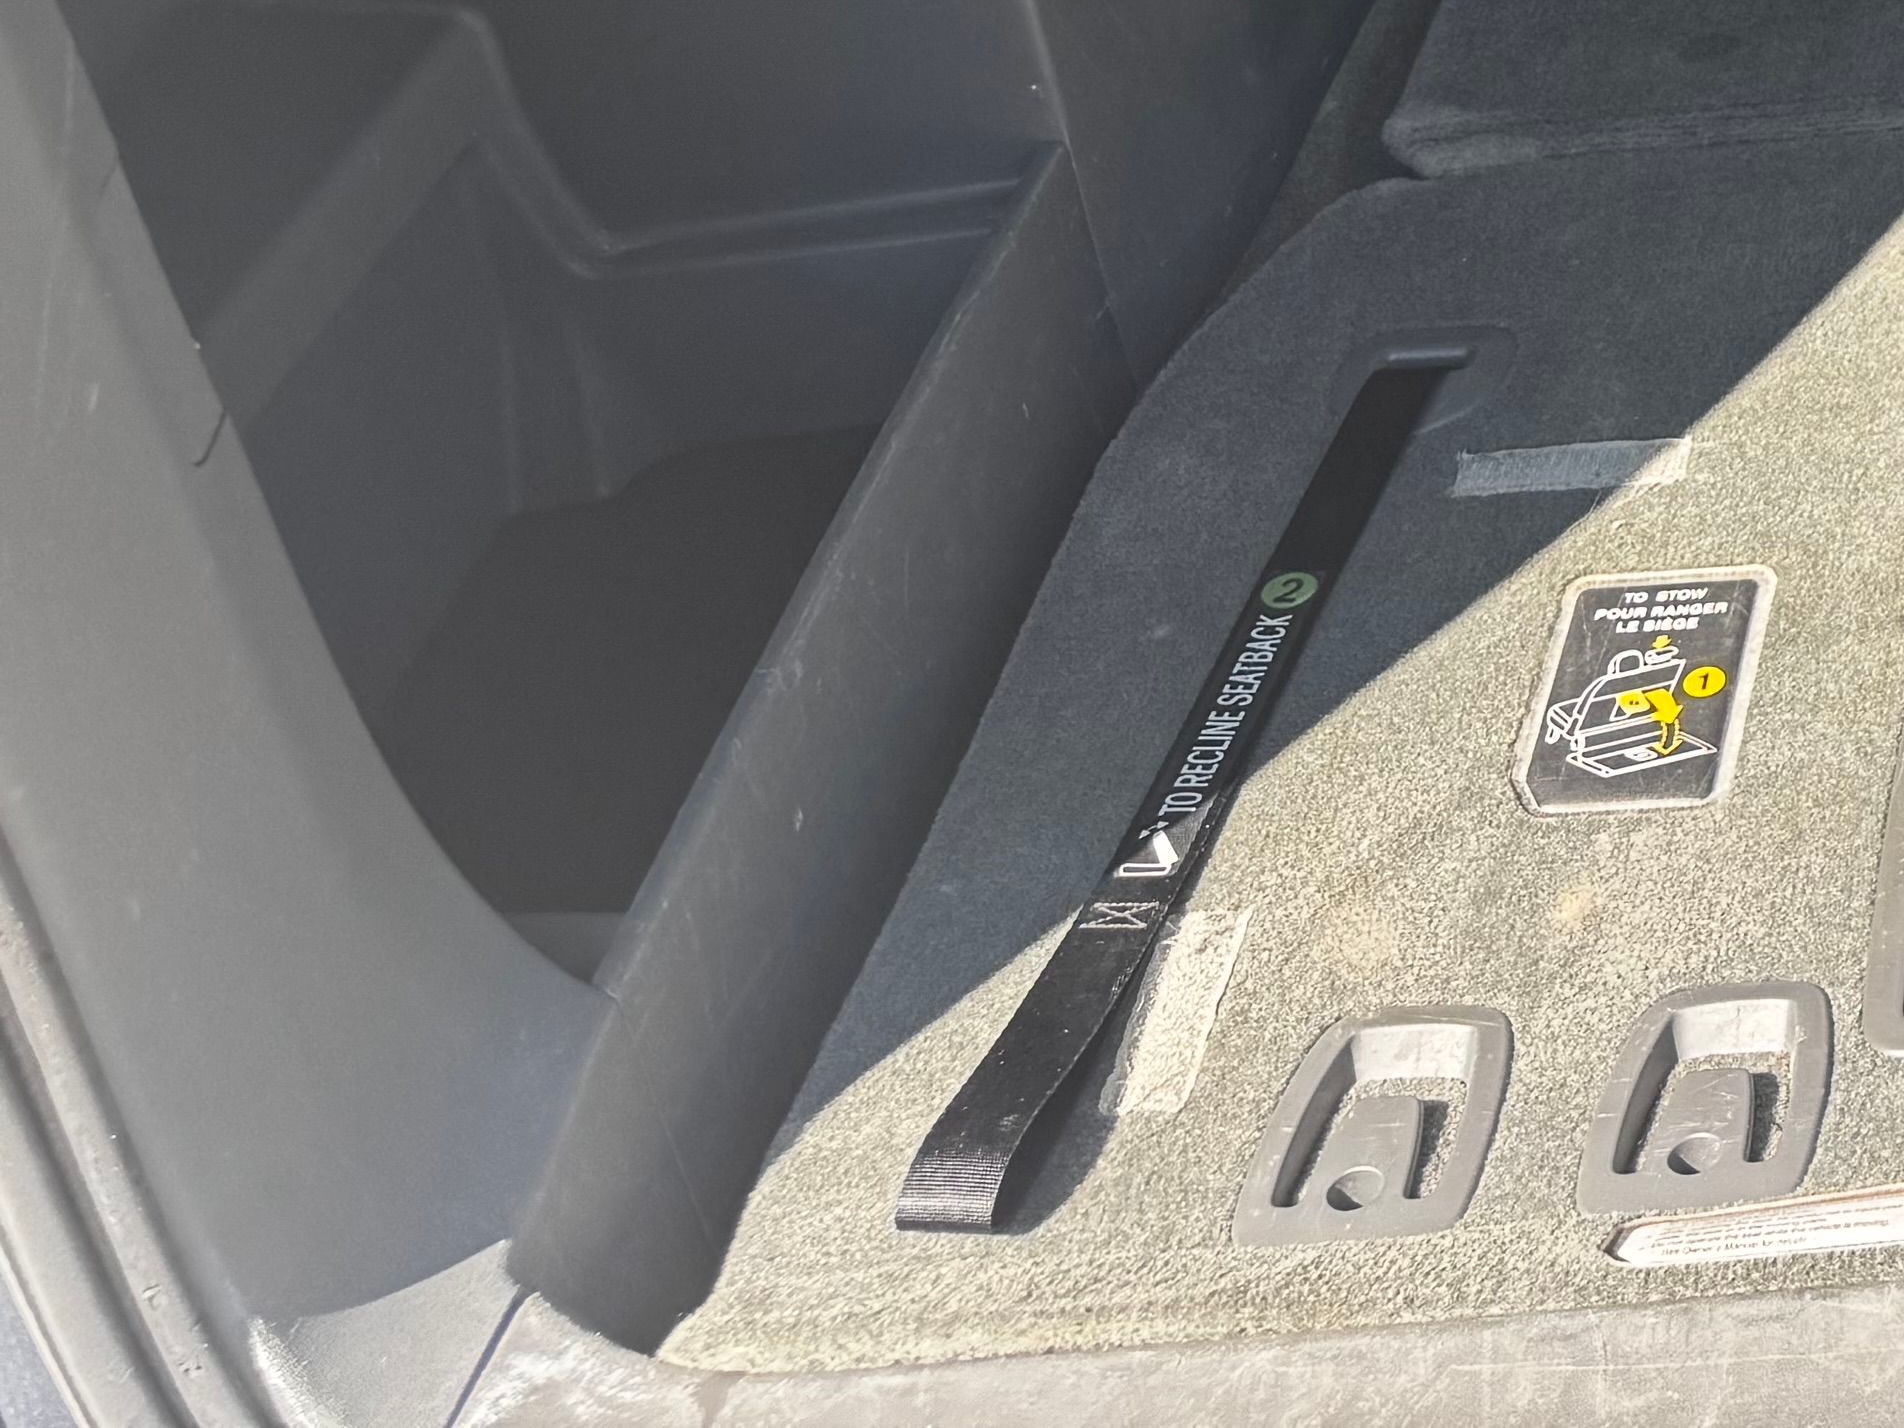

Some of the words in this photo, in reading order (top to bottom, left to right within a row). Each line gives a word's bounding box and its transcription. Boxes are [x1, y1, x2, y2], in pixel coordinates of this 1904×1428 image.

[1272, 578, 1304, 604] 2
[1624, 591, 1649, 604] TO
[1655, 587, 1709, 603] STOW
[1594, 606, 1648, 621] POUR
[1650, 601, 1729, 618] RANGER
[1615, 620, 1640, 634] LE
[1216, 613, 1293, 707] SEATBACK
[1699, 673, 1713, 691] 1
[1173, 710, 1246, 788] RECLINE
[1157, 791, 1203, 817] TO
